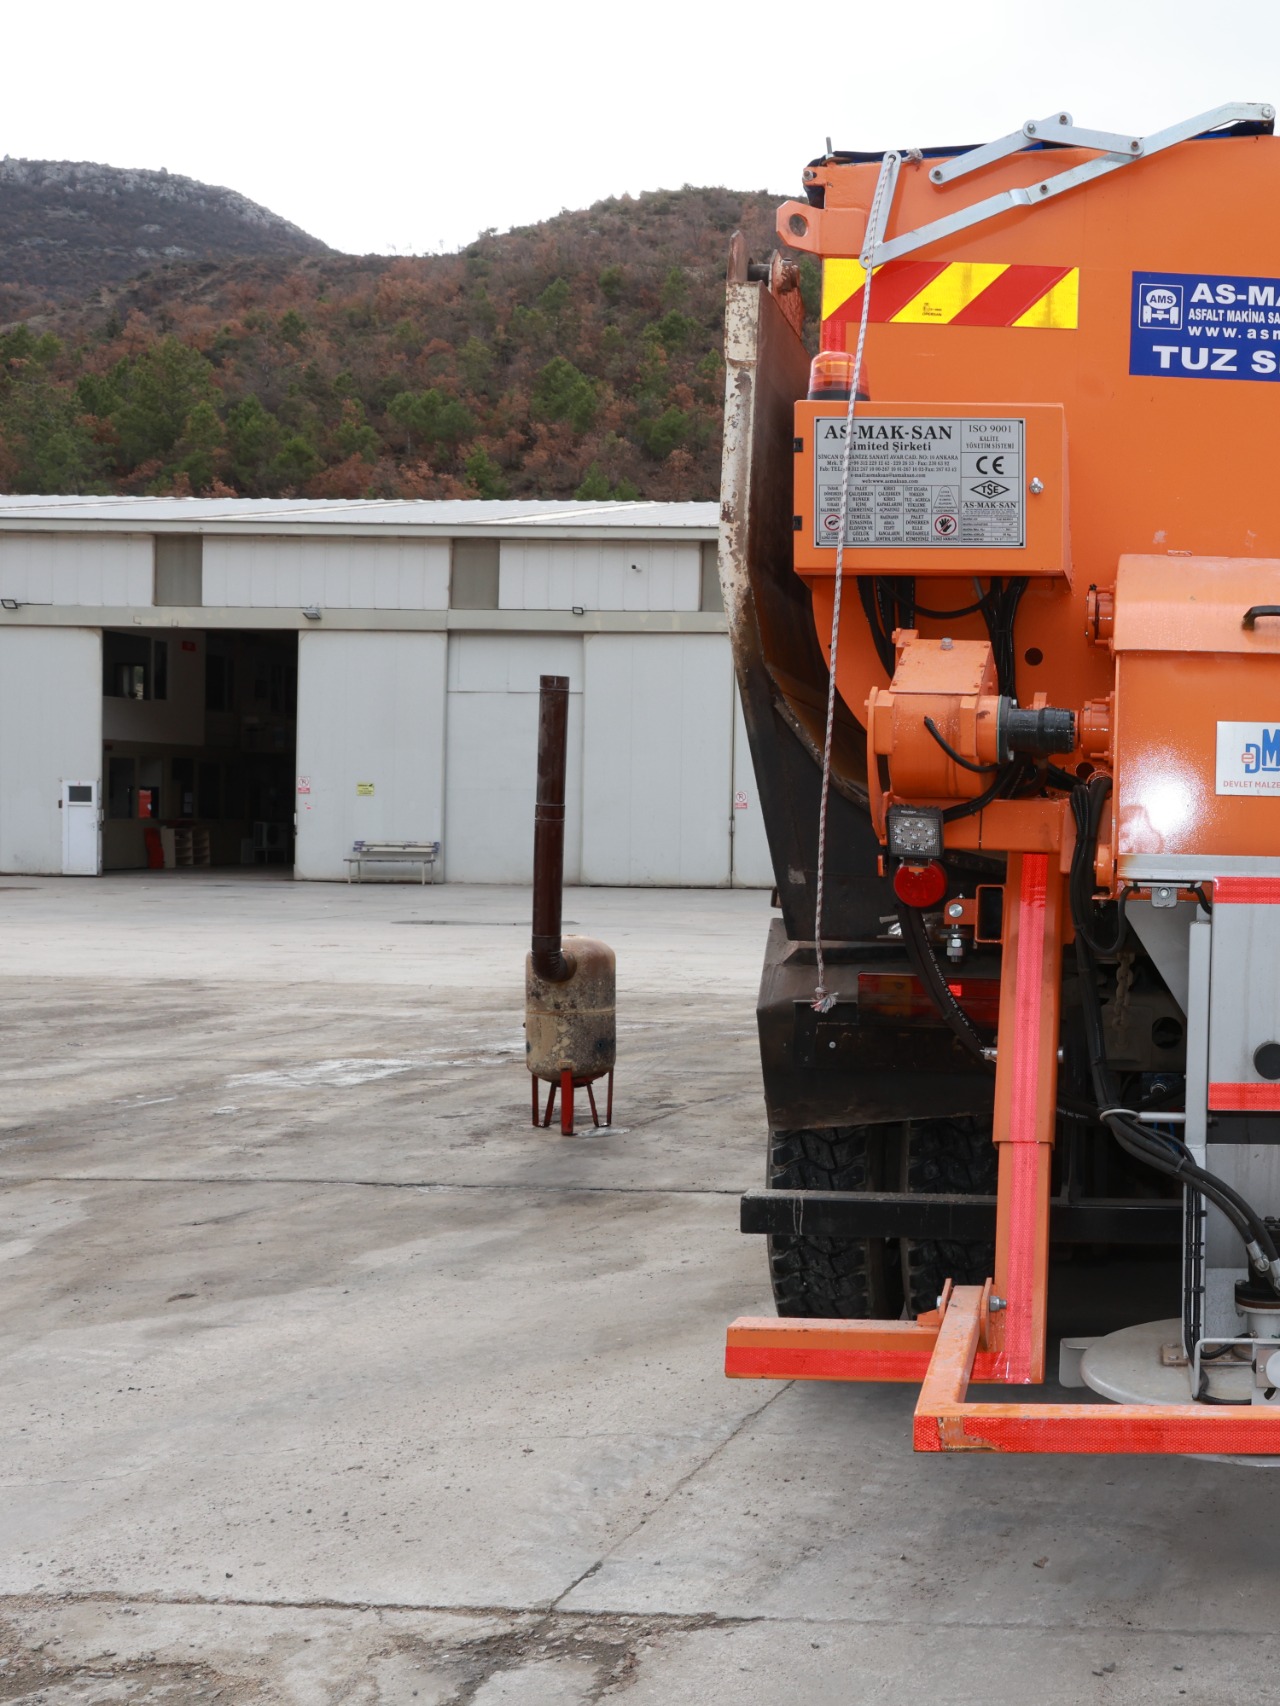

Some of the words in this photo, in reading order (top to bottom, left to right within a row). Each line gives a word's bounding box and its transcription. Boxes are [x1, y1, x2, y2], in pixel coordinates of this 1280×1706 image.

[1149, 294, 1174, 304] AMS
[1188, 308, 1224, 321] ASFALT
[1227, 308, 1265, 323] MAKİNA
[1152, 345, 1238, 372] TUZ
[824, 425, 952, 439] AS-MAK-SAN
[848, 442, 889, 451] imited
[892, 441, 931, 453] Şirketi
[976, 456, 1004, 474] CE
[981, 484, 999, 495] TSE
